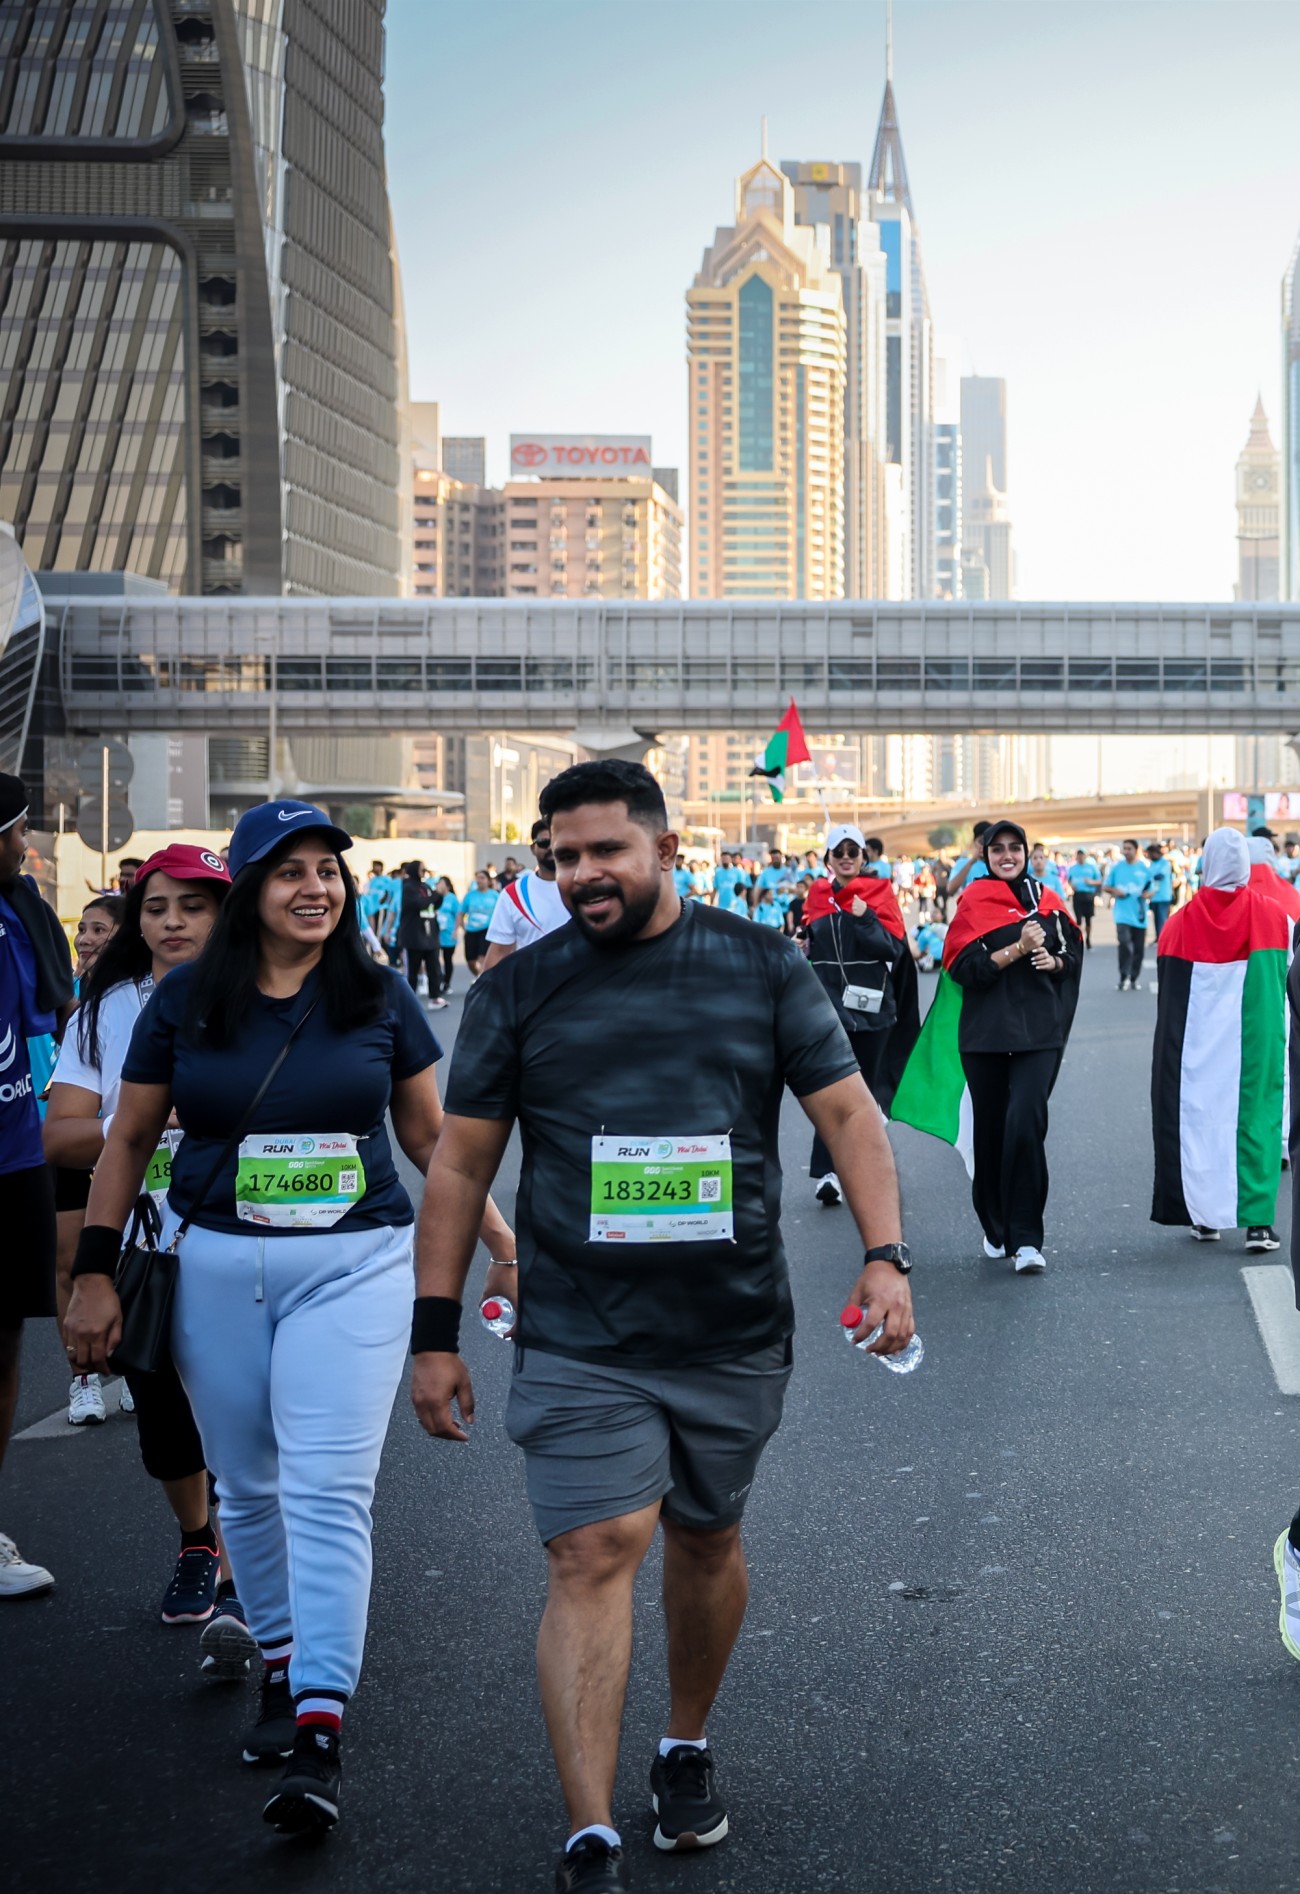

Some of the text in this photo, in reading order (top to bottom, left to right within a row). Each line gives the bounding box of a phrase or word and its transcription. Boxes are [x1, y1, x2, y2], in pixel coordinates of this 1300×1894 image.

[552, 446, 650, 465] TOYOTA
[263, 1145, 294, 1153] RUN
[618, 1147, 650, 1156] RUN
[249, 1174, 333, 1192] 174680
[603, 1181, 692, 1201] 183243
